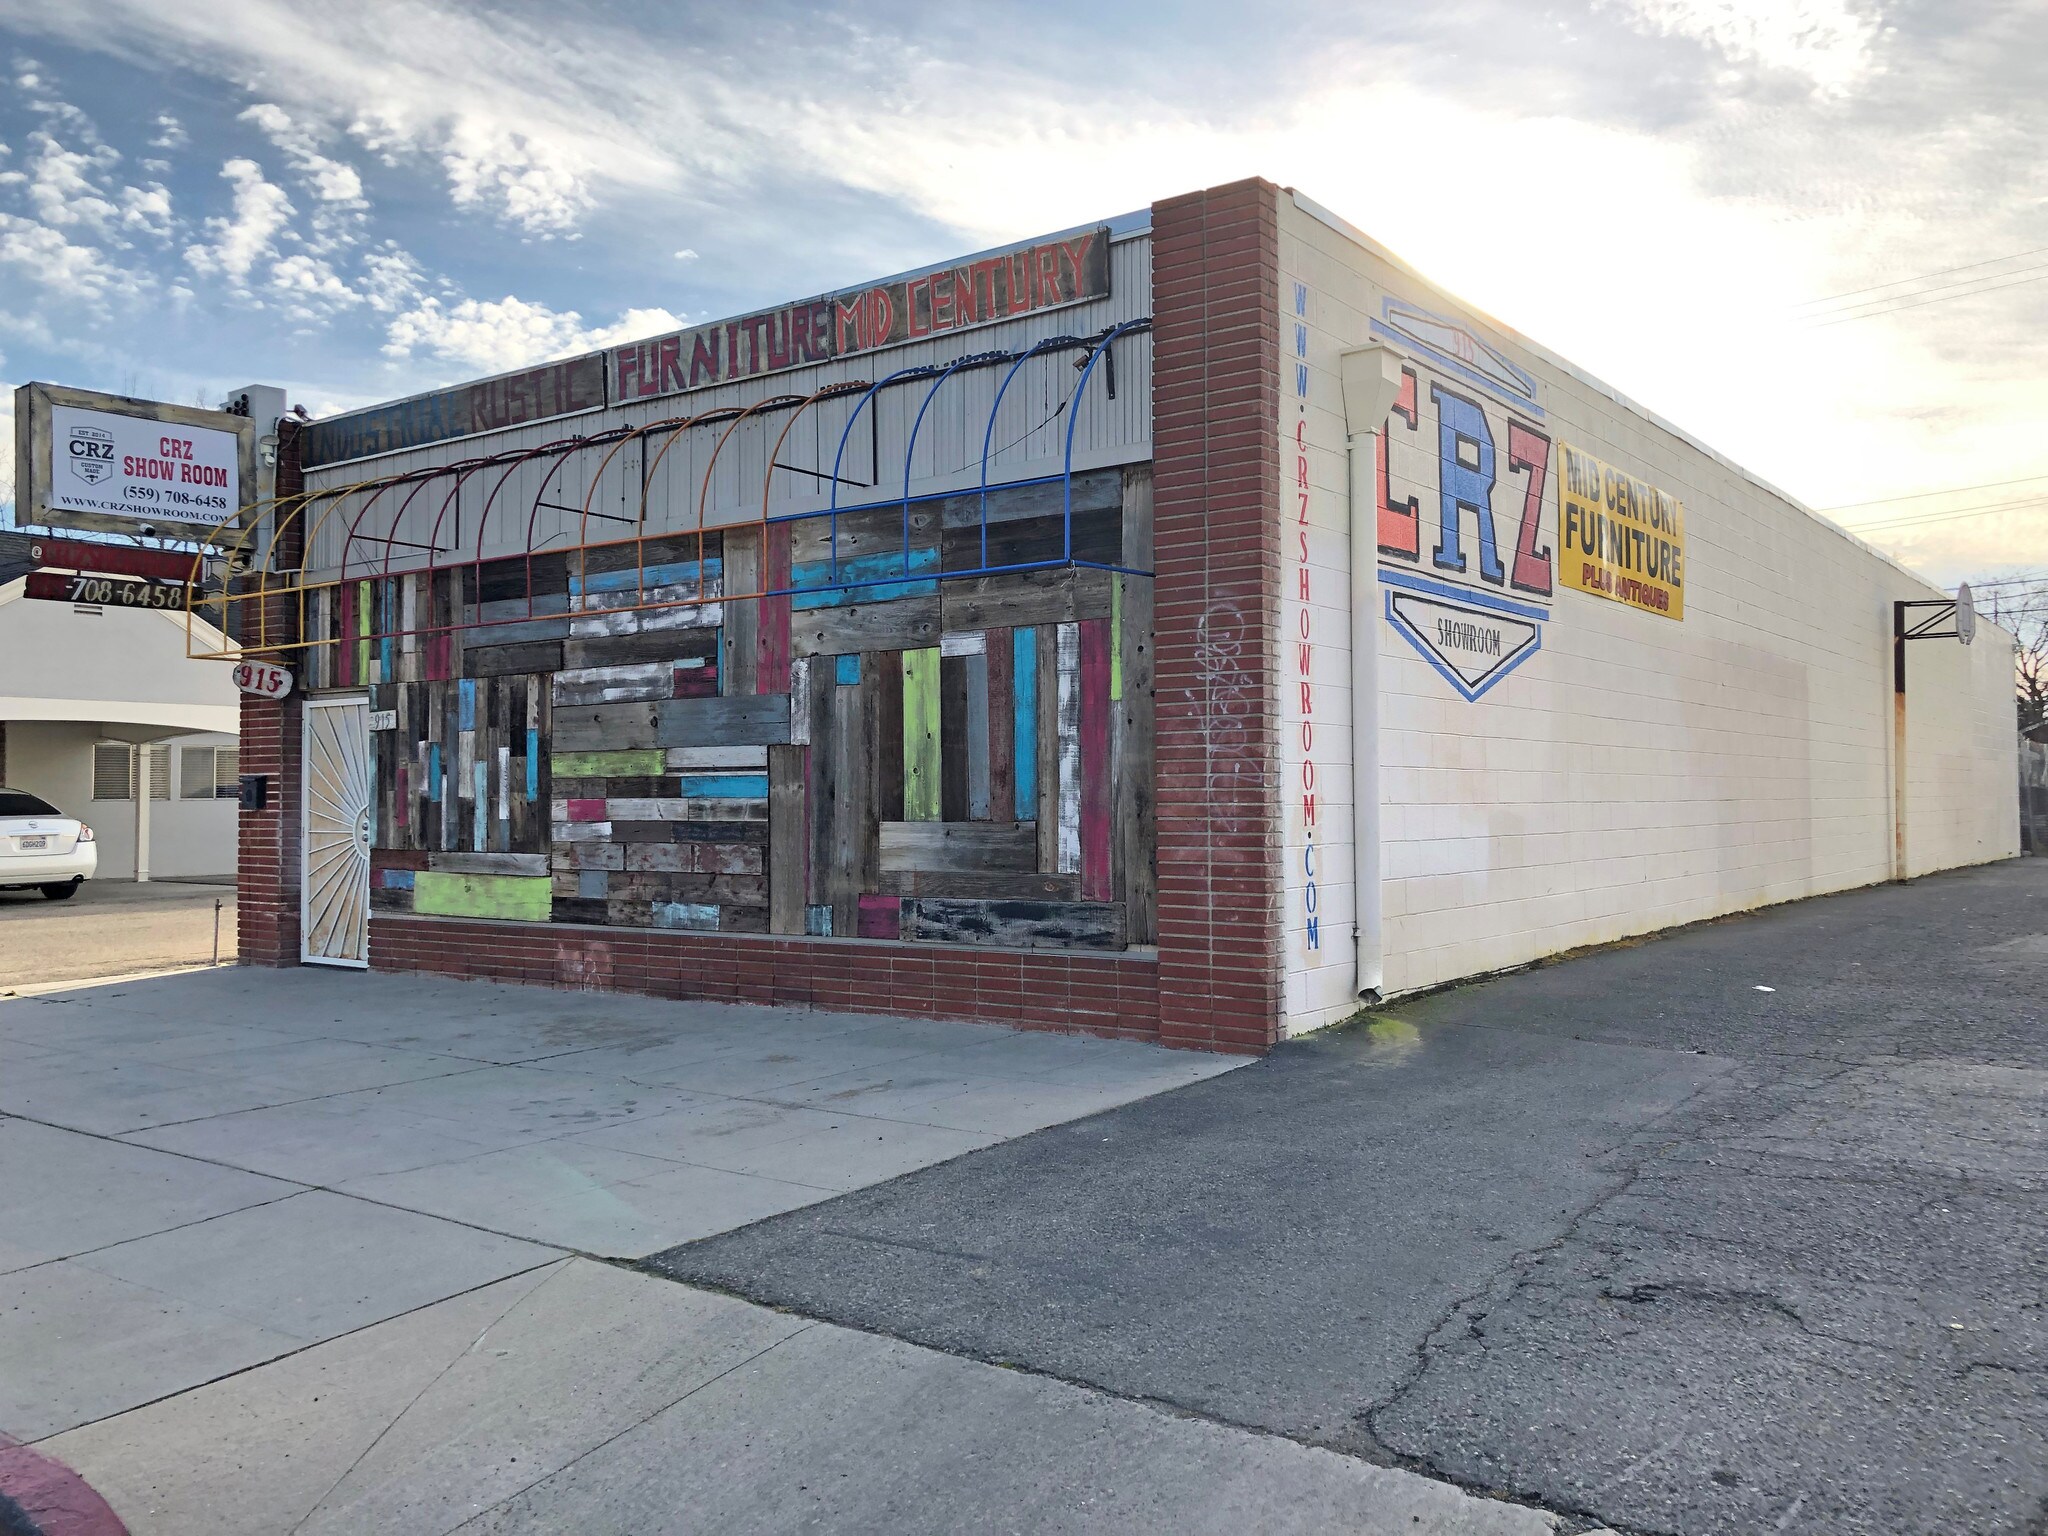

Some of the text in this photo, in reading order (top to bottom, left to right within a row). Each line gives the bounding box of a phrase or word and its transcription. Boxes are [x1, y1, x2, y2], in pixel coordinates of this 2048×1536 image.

[470, 358, 587, 432] RUSTIC
[617, 302, 828, 400] FURNITURE
[836, 288, 894, 354] MID
[906, 234, 1093, 338] CENTURY
[69, 439, 114, 460] CRZ
[159, 436, 194, 460] CRZ
[80, 462, 104, 470] CUSTOM
[123, 455, 228, 488] SHOW ROOM
[123, 485, 227, 509] (559) 708-6458
[1565, 447, 1678, 538] MID CENTURY
[61, 496, 228, 522] WWW.CRZSHOWROOM.COM
[1565, 501, 1682, 588] FURNITURE
[1582, 562, 1670, 612] PLUS ANTIQUES
[1437, 617, 1501, 657] SHOWROOM
[240, 665, 282, 693] 915
